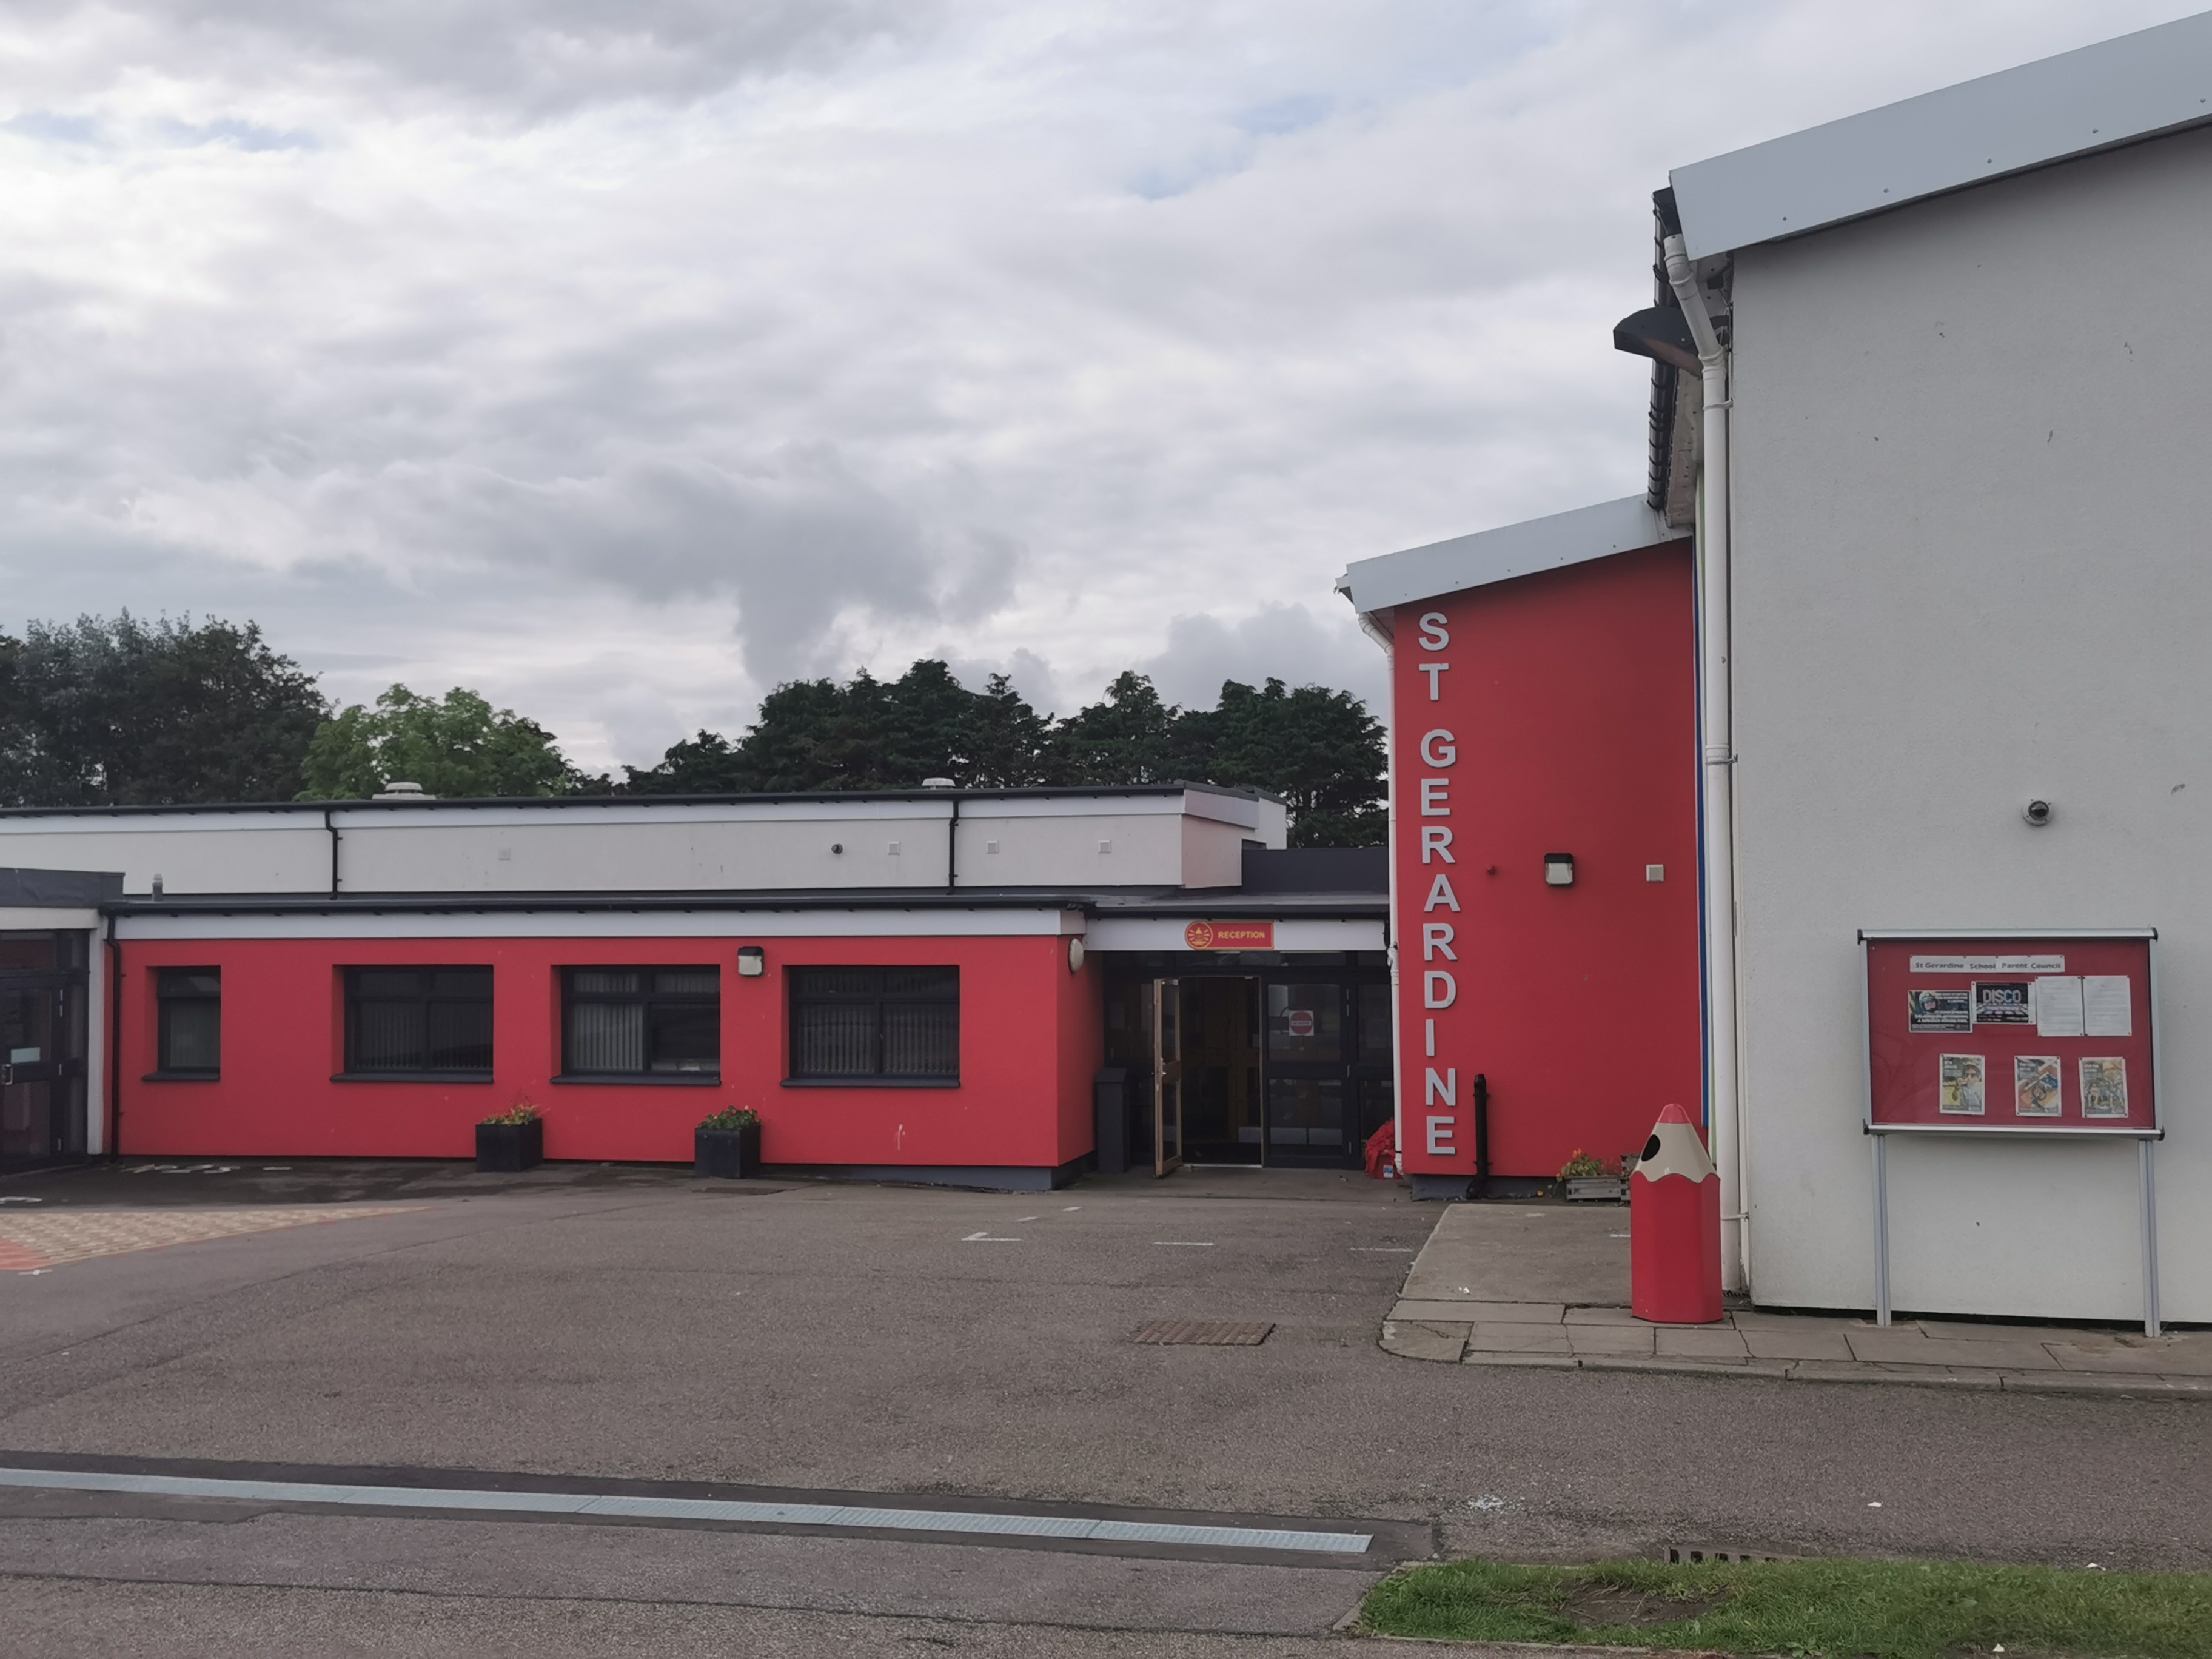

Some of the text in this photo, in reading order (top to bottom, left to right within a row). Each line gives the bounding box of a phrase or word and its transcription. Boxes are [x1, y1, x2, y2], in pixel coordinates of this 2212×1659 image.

[1418, 611, 1461, 1155] ST GERARDINE
[1983, 989, 2022, 1004] DISCO
